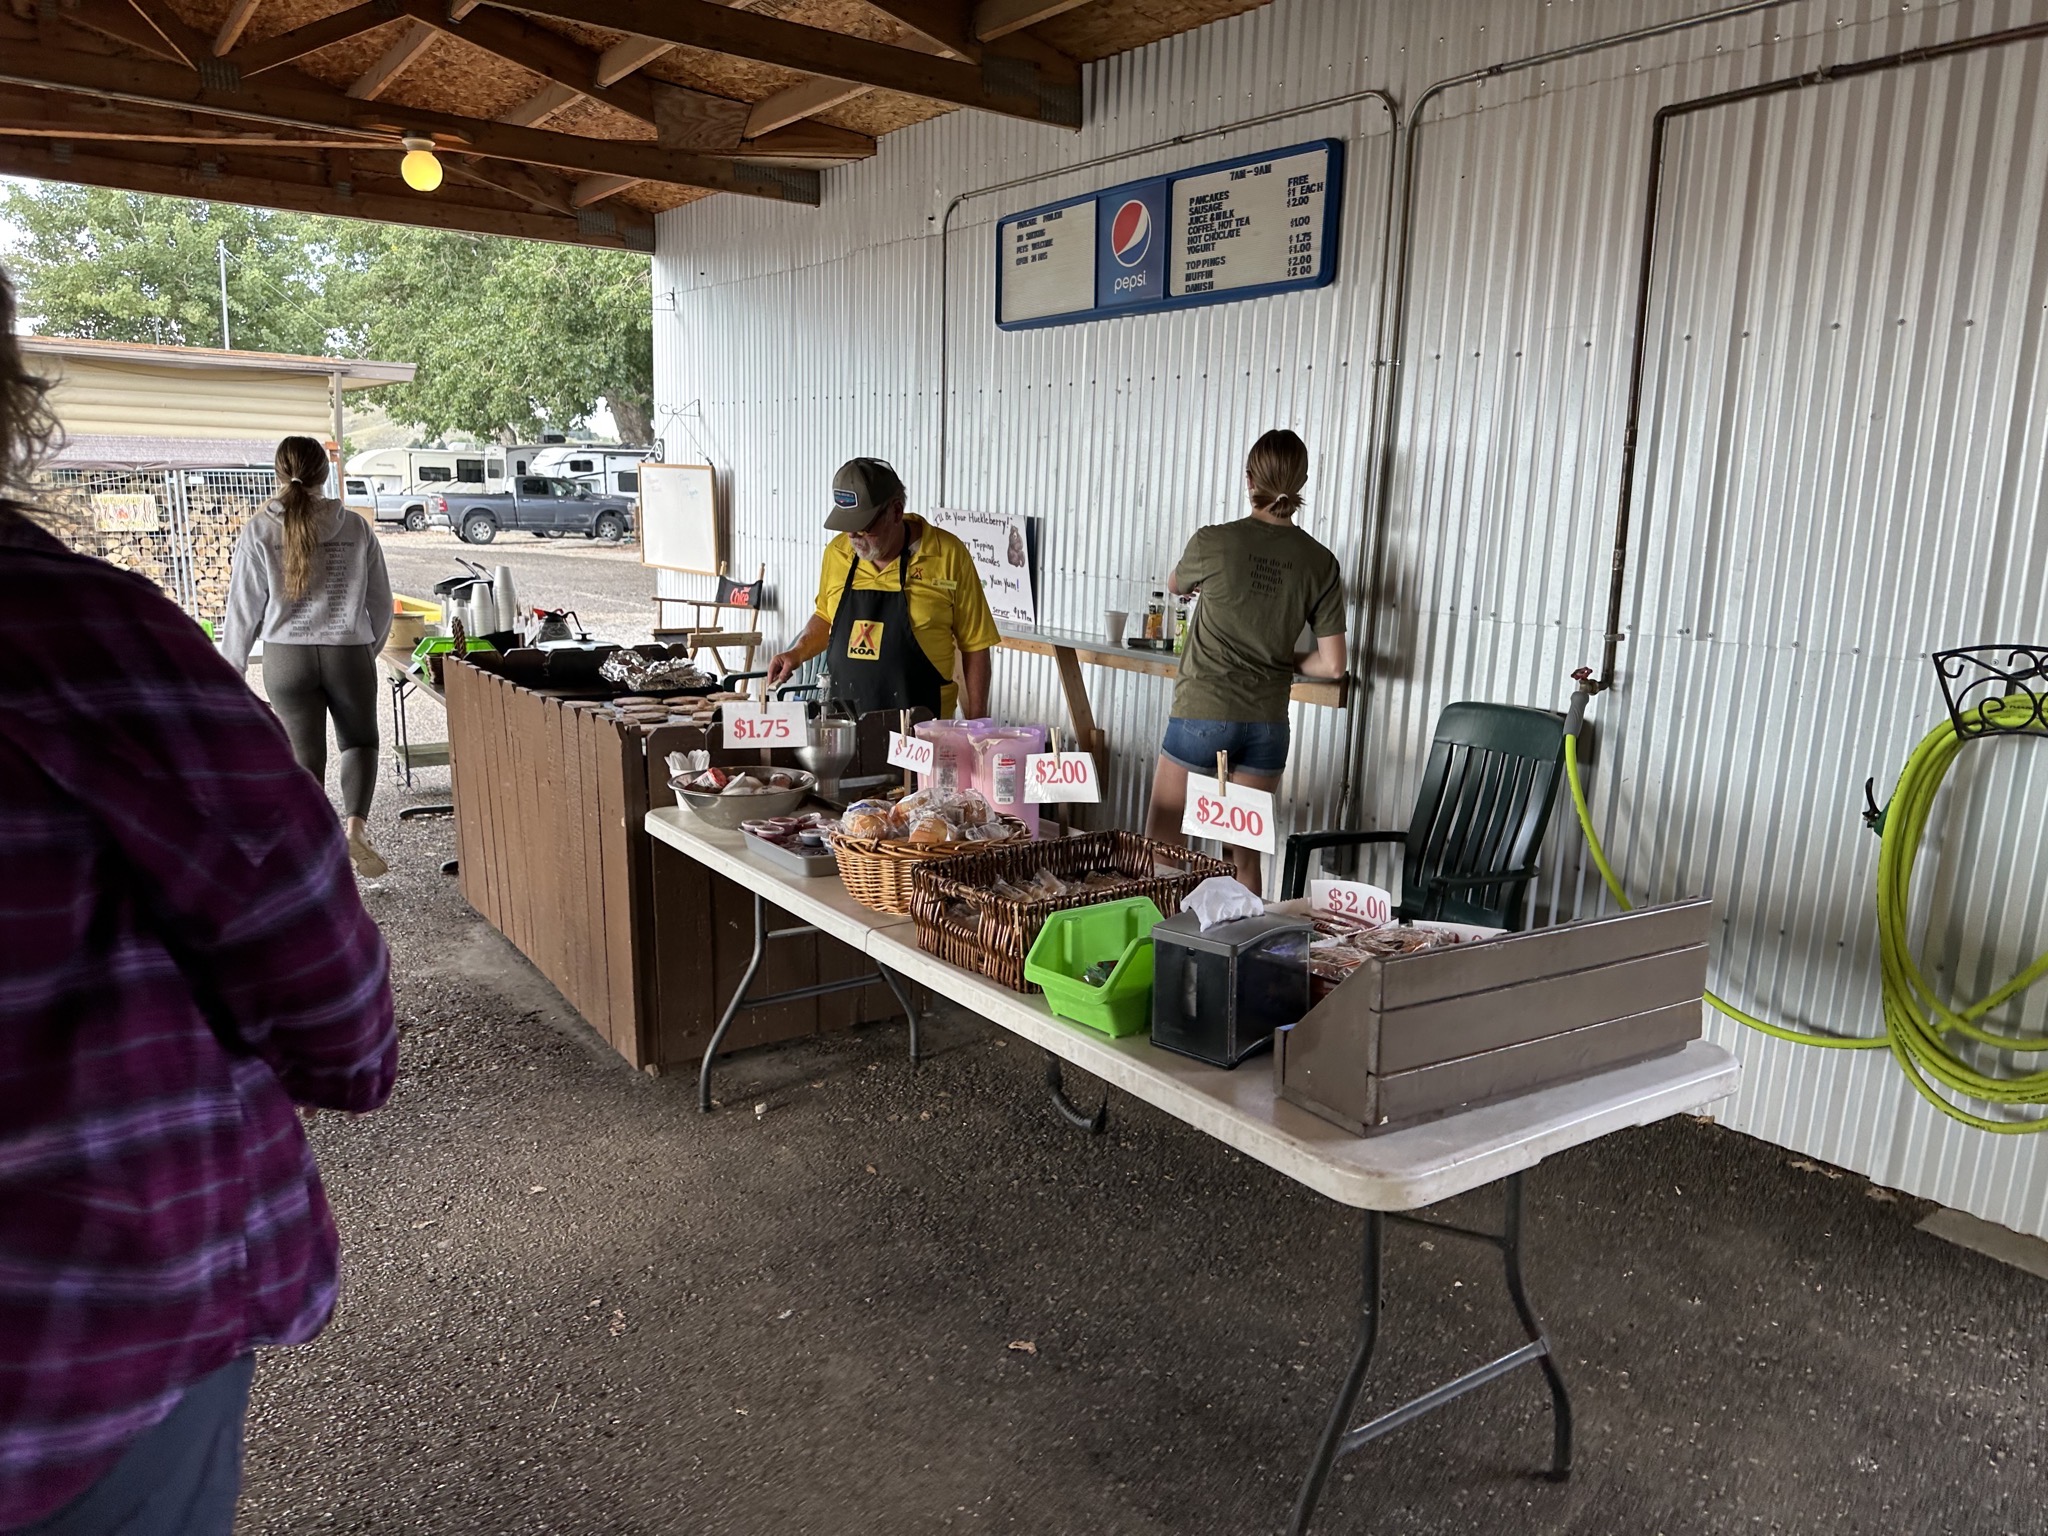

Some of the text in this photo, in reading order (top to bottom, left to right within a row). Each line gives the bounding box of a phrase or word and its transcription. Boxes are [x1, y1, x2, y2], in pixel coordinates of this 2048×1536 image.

[1229, 163, 1272, 181] 7AM-9AM
[1189, 174, 1309, 206] PANCAKES FREE
[1189, 182, 1324, 216] SAUSAGE $1 EACH
[1188, 214, 1208, 226] JUICE
[1218, 219, 1233, 230] HOT
[1235, 216, 1251, 227] TEA
[1016, 238, 1054, 254] PETS WELCOME
[1188, 234, 1203, 246] HOT
[1186, 242, 1311, 270] TOPPINGS $1.00
[1187, 242, 1217, 255] YOGURT
[1185, 254, 1312, 282] MUFFIN $2.00
[1114, 270, 1146, 294] pepsi
[1185, 281, 1214, 293] DANISH
[944, 511, 952, 521] Be
[953, 512, 967, 526] Your
[972, 538, 995, 558] Topping
[976, 552, 1001, 568] Pancakes
[1254, 556, 1268, 565] can
[1270, 558, 1280, 567] do
[1282, 560, 1293, 570] all
[1250, 570, 1283, 585] through
[1256, 563, 1282, 577] things
[989, 574, 1003, 589] Yum
[1252, 580, 1276, 593] Christ
[730, 588, 750, 606] Coke
[850, 647, 876, 656] KOA
[734, 718, 790, 740] $1.75
[1036, 760, 1088, 785] $2.00
[1196, 795, 1264, 837] $2.00
[1328, 888, 1387, 923] $2.00
